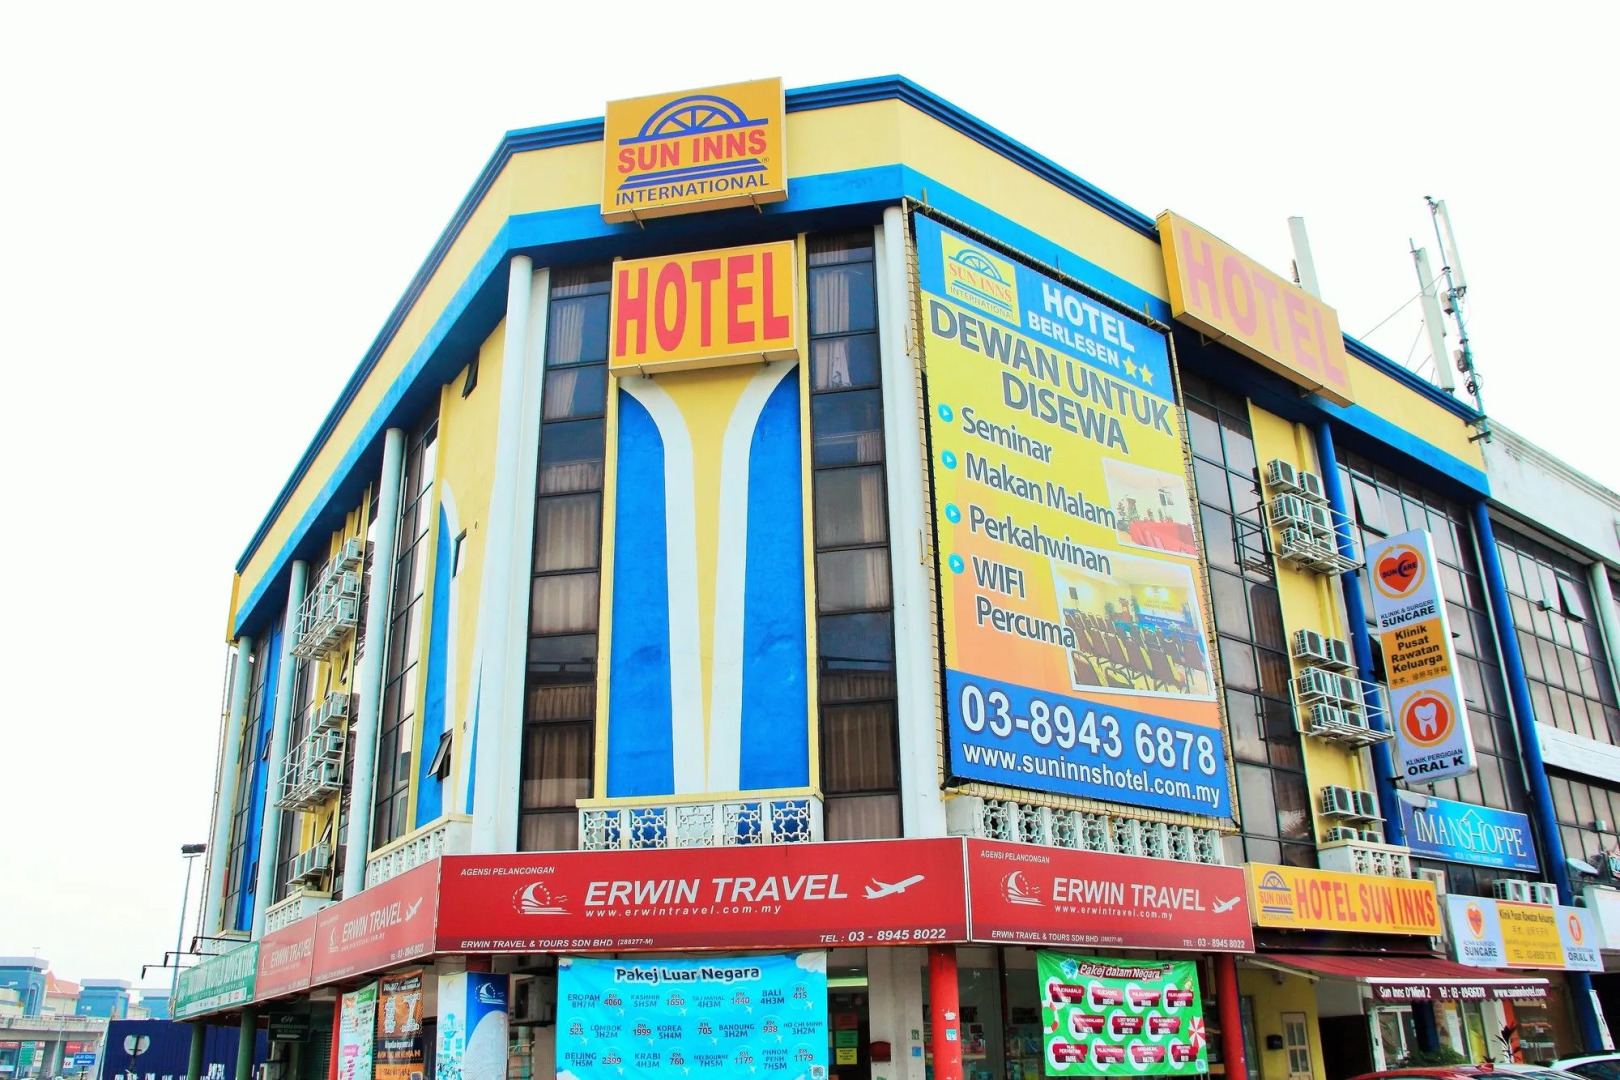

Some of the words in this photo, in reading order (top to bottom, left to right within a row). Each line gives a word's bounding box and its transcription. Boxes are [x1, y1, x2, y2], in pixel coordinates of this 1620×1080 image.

[617, 142, 680, 174] SUN
[692, 129, 767, 163] INNS
[615, 173, 770, 205] INTERNATIONAL
[949, 262, 976, 286] SUN
[980, 277, 1012, 302] INNS
[615, 251, 790, 358] HOTEL
[950, 286, 1016, 321] INTERNATIONAL
[1180, 229, 1346, 388] HOTEL
[1042, 282, 1135, 352] HOTEL
[1028, 311, 1120, 369] BERLESEN
[929, 298, 1060, 387] DEWAN
[1066, 360, 1173, 437] UNTUK
[1001, 370, 1129, 455] DISEWA
[961, 407, 1052, 464] Seminar
[965, 452, 1043, 501] Makan
[1046, 482, 1117, 530] Malam
[968, 504, 1111, 575] Perkahwinan
[976, 595, 1076, 649] Percuma
[1382, 605, 1435, 628] SUNCARE
[1395, 625, 1427, 641] Klinik
[1397, 635, 1429, 651] Pusat
[1391, 644, 1440, 664] Rawatan
[1392, 654, 1443, 674] Keluarga
[961, 684, 1123, 758] 03-8943
[1135, 722, 1216, 776] 6878
[1406, 756, 1427, 766] KLINIK
[1408, 760, 1449, 776] ORAL
[1453, 756, 1465, 766] K
[963, 743, 1220, 808] www.suninnshotel.com.my
[980, 850, 1004, 860] AGENSI
[1005, 852, 1050, 864] PELANCONGAN
[461, 868, 491, 876] AGENSI
[492, 866, 555, 876] PELANCONGAN
[585, 878, 701, 906] ERWIN
[712, 874, 848, 903] TRAVEL
[1052, 876, 1125, 906] ERWIN
[1130, 884, 1206, 912] TRAVEL
[1259, 891, 1274, 904] SUN
[585, 905, 781, 918] www.erwintravel.com.my
[1055, 904, 1173, 920] www.erwintravel.com.my
[1294, 877, 1357, 922] HOTEL
[1358, 883, 1395, 924] SUN
[1396, 887, 1436, 927] INNS
[342, 914, 368, 943] ERWIN
[369, 901, 402, 933] TRAVEL
[461, 940, 490, 948] ERWIN
[492, 940, 526, 948] TRAVEL
[538, 939, 569, 947] TOURS
[571, 939, 591, 947] SDN
[593, 939, 613, 947] BHD
[617, 938, 654, 946] (288277-M)
[819, 934, 839, 943] TEL
[848, 931, 865, 942] 03
[877, 930, 910, 941] 8945
[913, 928, 946, 940] 8022
[992, 930, 1014, 939] ERWIN
[1016, 931, 1040, 940] TRAVEL
[1049, 933, 1070, 941] TOURS
[1071, 934, 1084, 942] SDN
[1183, 939, 1192, 947] TEL
[1198, 939, 1206, 948] 03
[1212, 939, 1228, 948] 8945
[1229, 940, 1245, 949] 8022
[1464, 946, 1498, 957] SUNCARE
[1568, 951, 1587, 962] ORAL
[616, 968, 658, 983] Pakej
[662, 969, 696, 980] Luar
[702, 968, 759, 982] Negara
[1080, 964, 1105, 978] Pakej
[1106, 966, 1133, 978] dalam
[1133, 968, 1160, 980] Negara
[793, 992, 807, 1000] 415
[1380, 986, 1392, 998] Sun
[1426, 986, 1431, 998] 2
[724, 1030, 748, 1038] 3H2M
[565, 1052, 597, 1060] BEIJING
[764, 1062, 787, 1070] 7H5M
